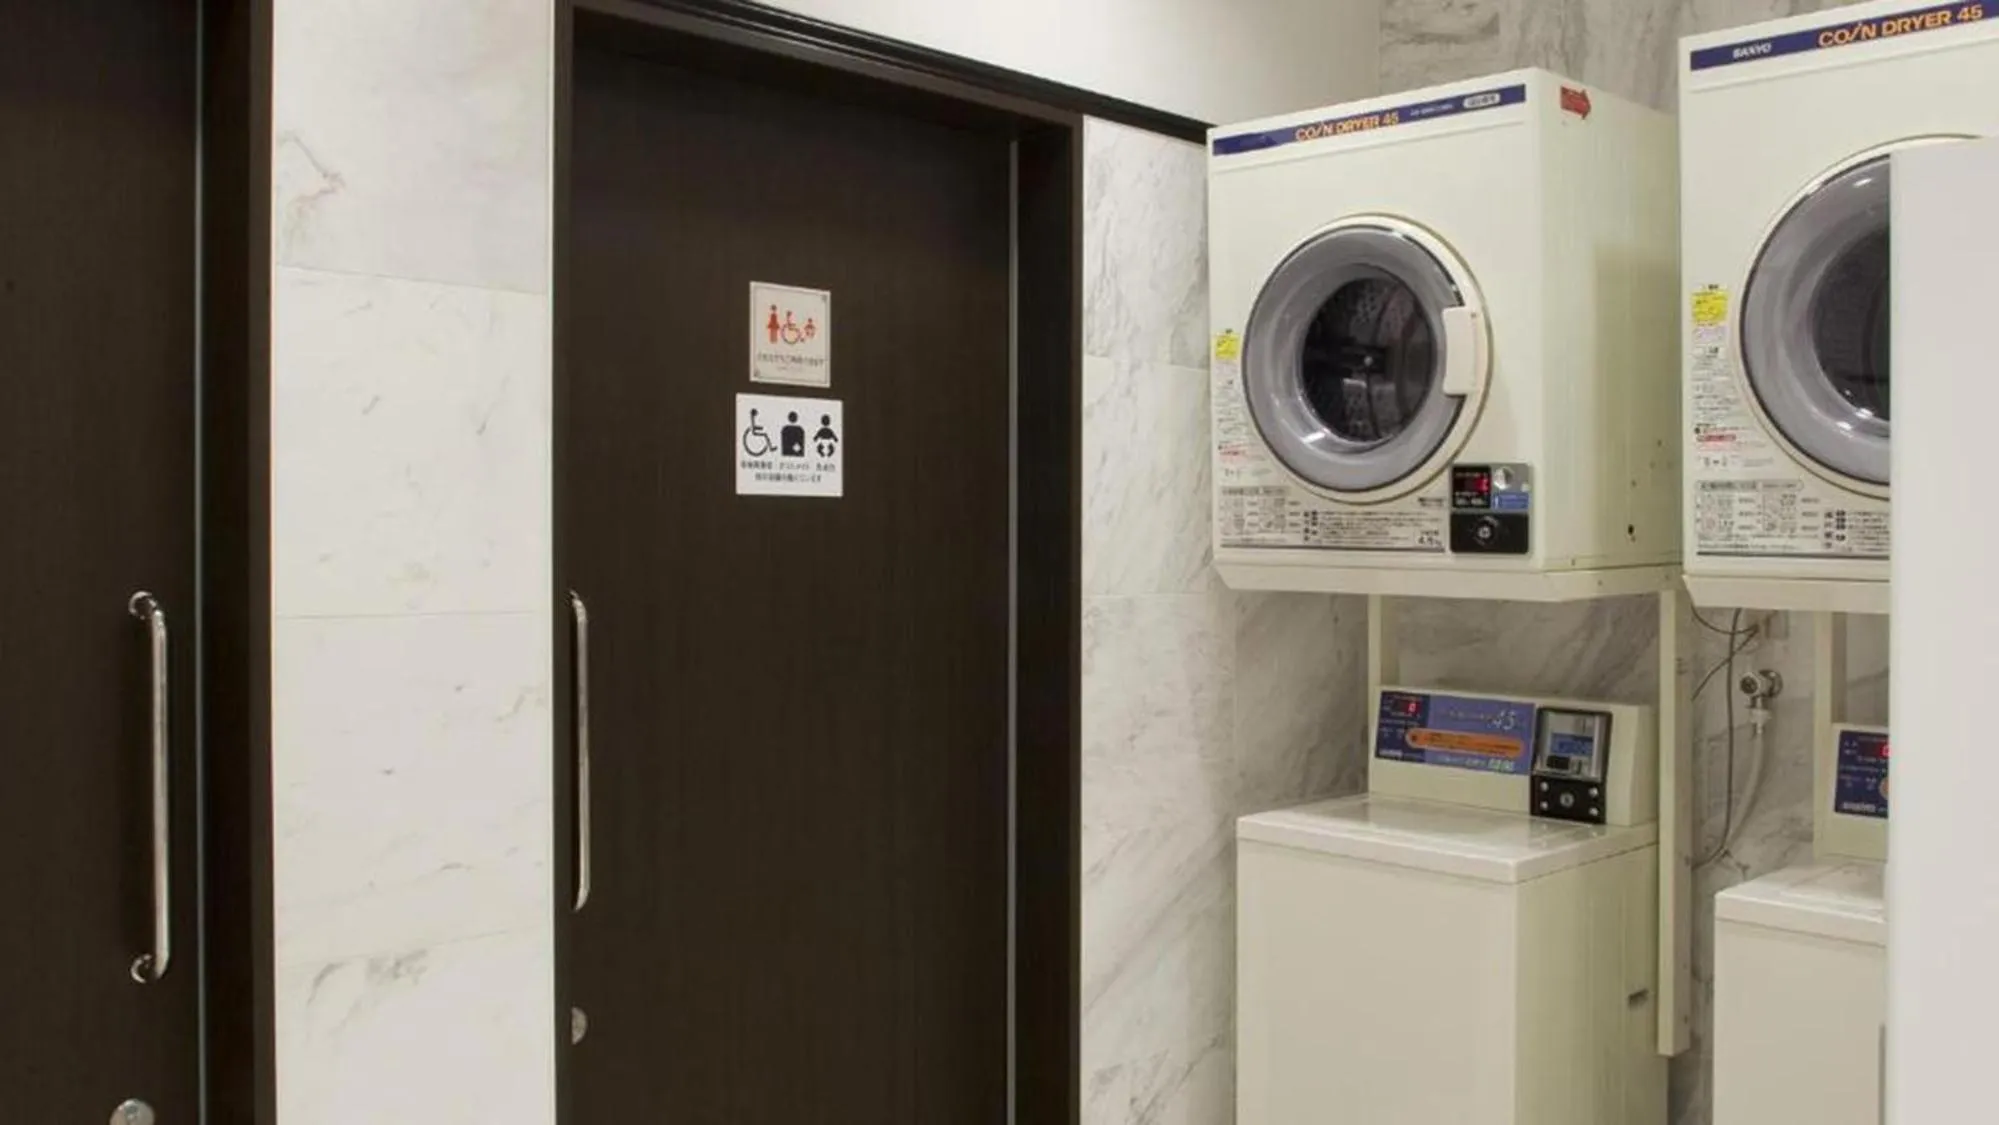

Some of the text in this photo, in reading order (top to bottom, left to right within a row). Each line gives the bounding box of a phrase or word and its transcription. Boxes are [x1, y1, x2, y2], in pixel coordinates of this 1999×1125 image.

[1881, 10, 1952, 37] DRYER
[1957, 4, 1983, 21] 45
[1335, 115, 1380, 134] DRYER
